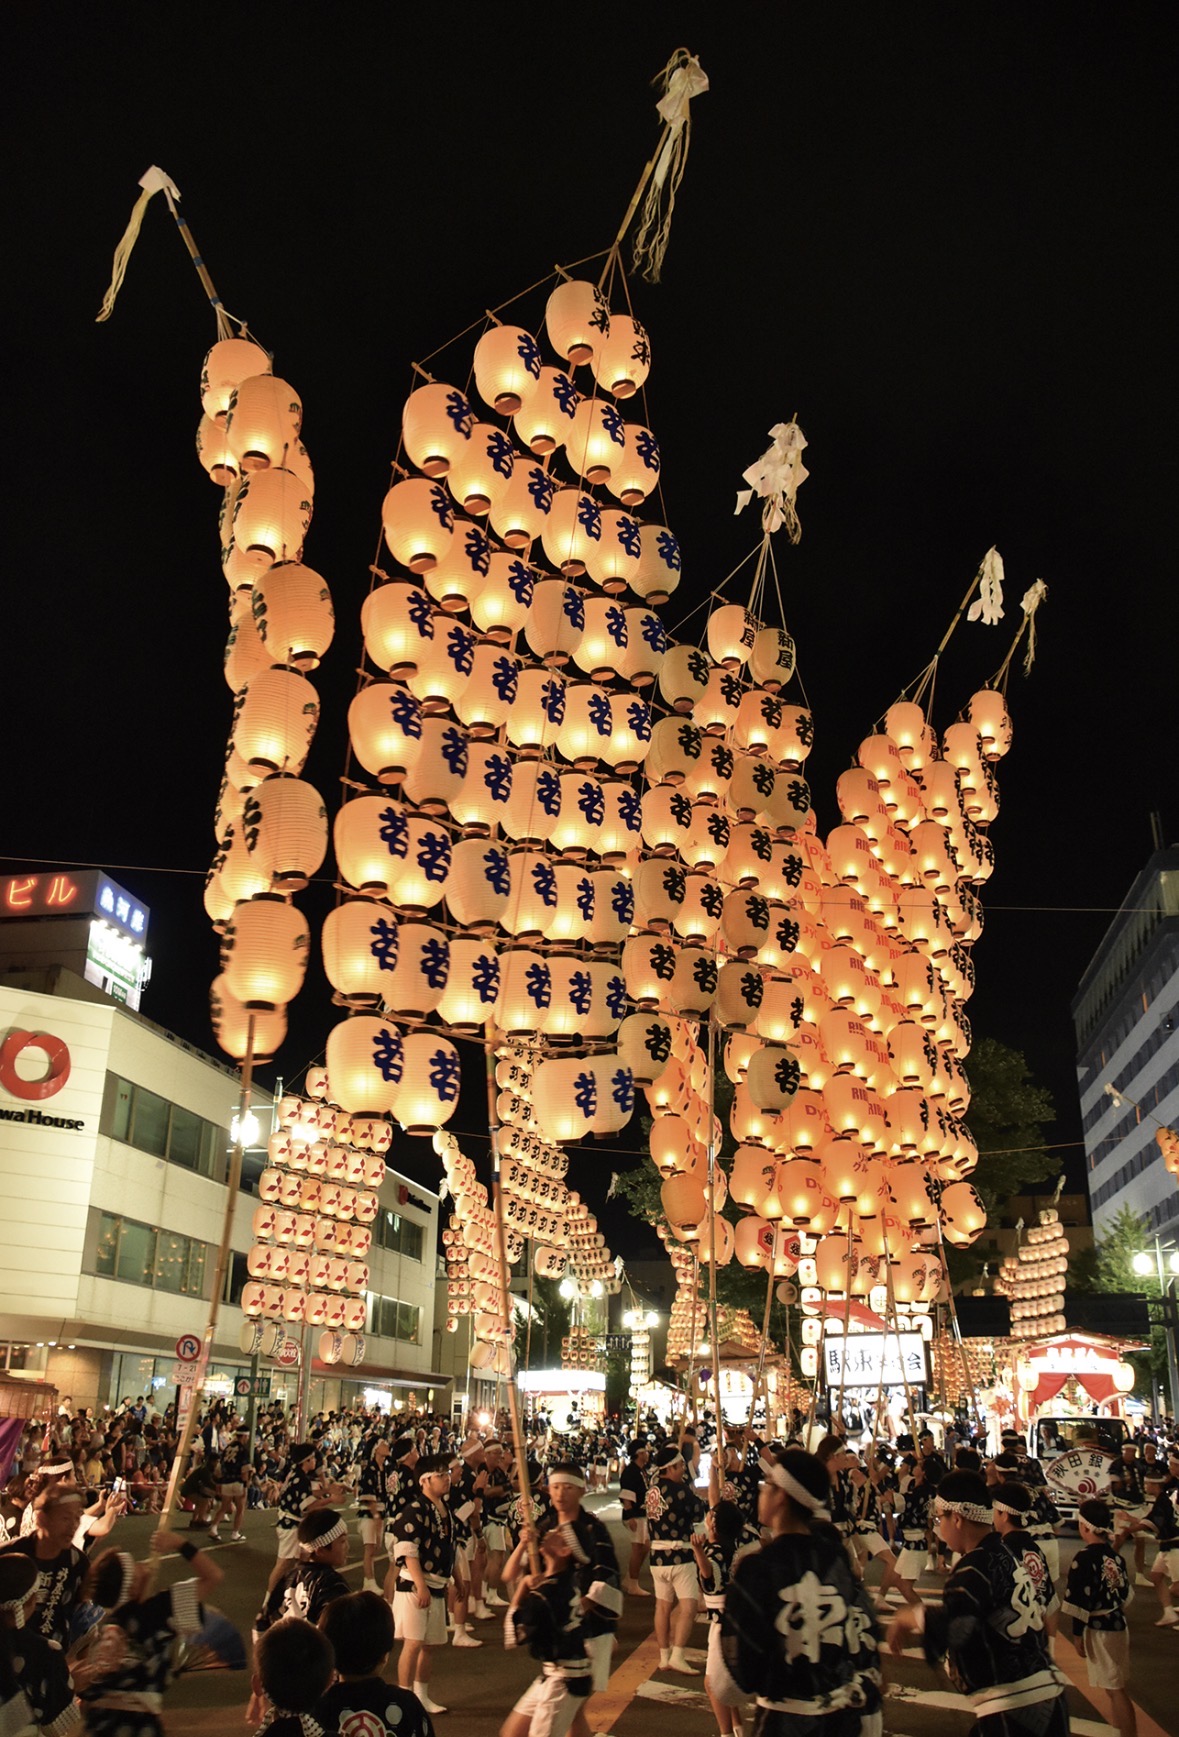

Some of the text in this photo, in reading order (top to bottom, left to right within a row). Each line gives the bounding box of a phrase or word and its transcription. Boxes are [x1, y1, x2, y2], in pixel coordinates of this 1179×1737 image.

[776, 630, 794, 671] 新屋
[8, 877, 77, 906] ビル
[1051, 1453, 1104, 1479] 秋田銀
